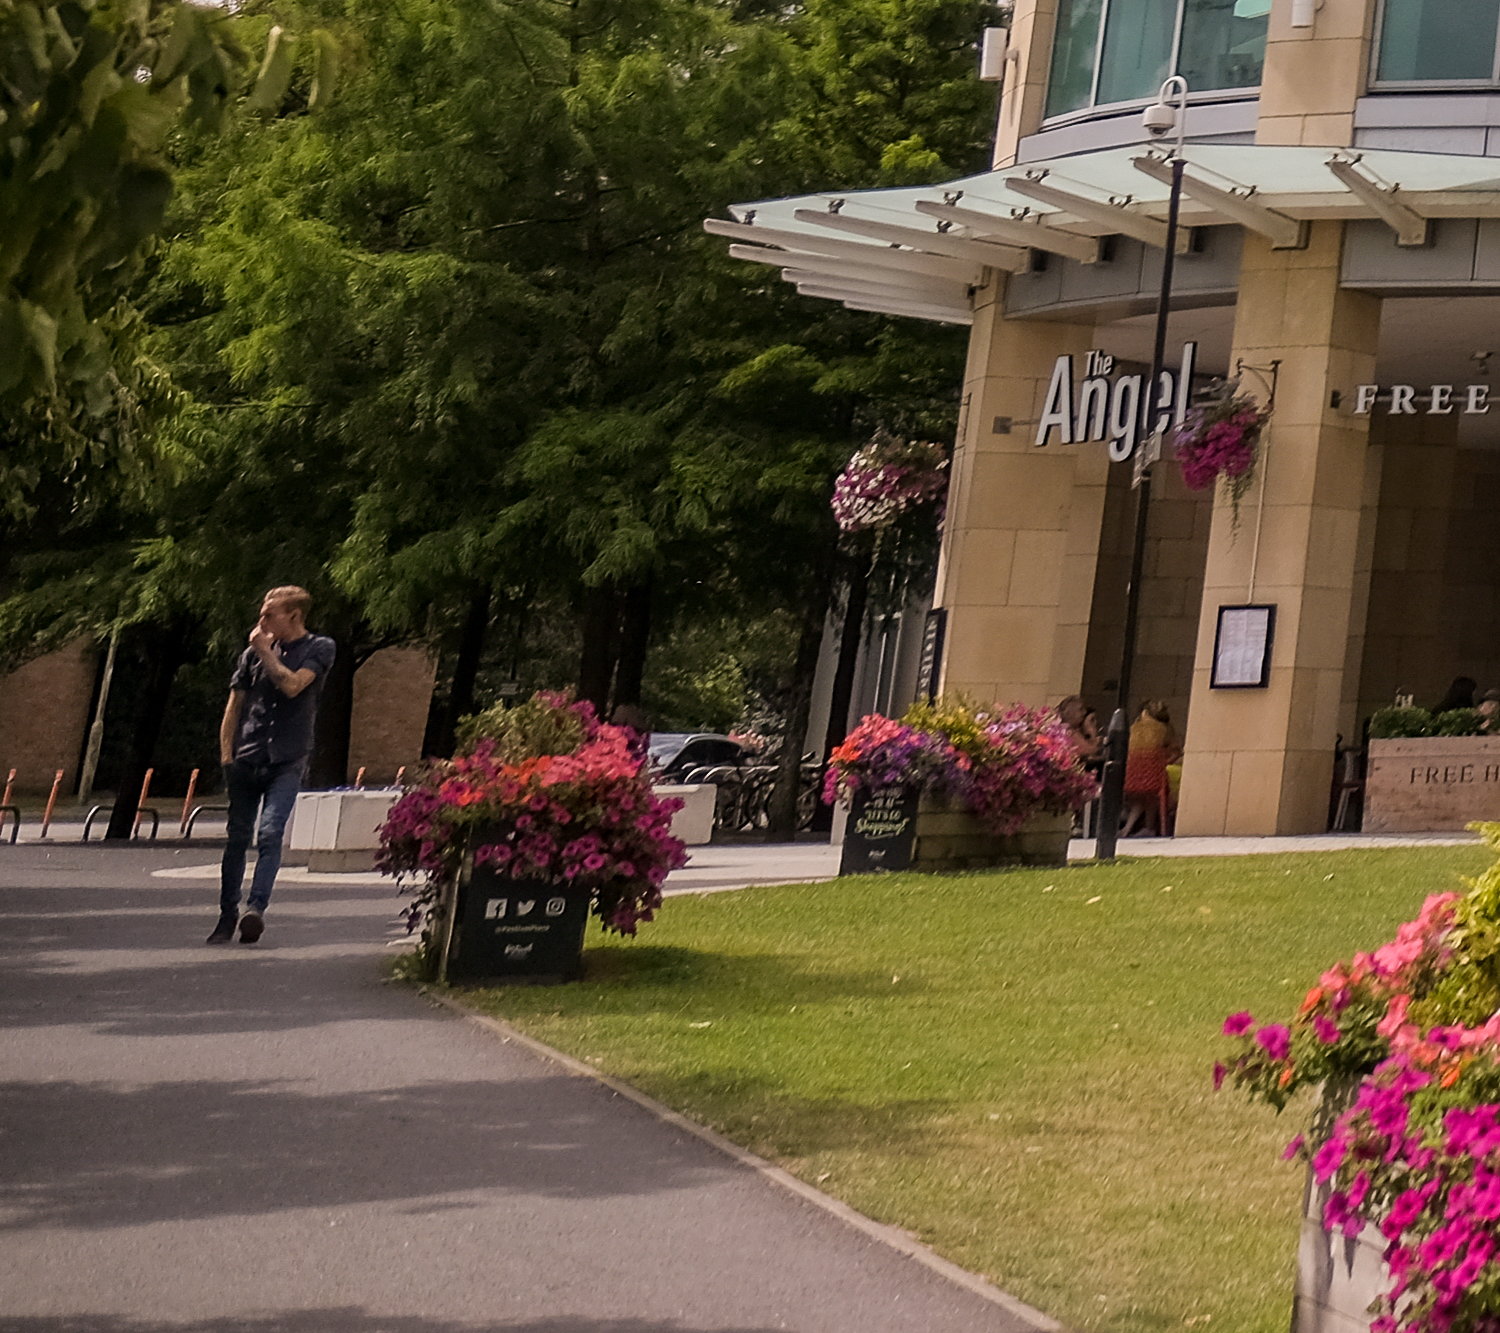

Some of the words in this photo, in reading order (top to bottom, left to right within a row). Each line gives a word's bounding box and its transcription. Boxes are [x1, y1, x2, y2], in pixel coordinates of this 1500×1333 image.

[1085, 350, 1113, 376] The
[1034, 341, 1195, 463] Angel
[1354, 384, 1490, 414] FREE
[1410, 765, 1474, 784] FREE
